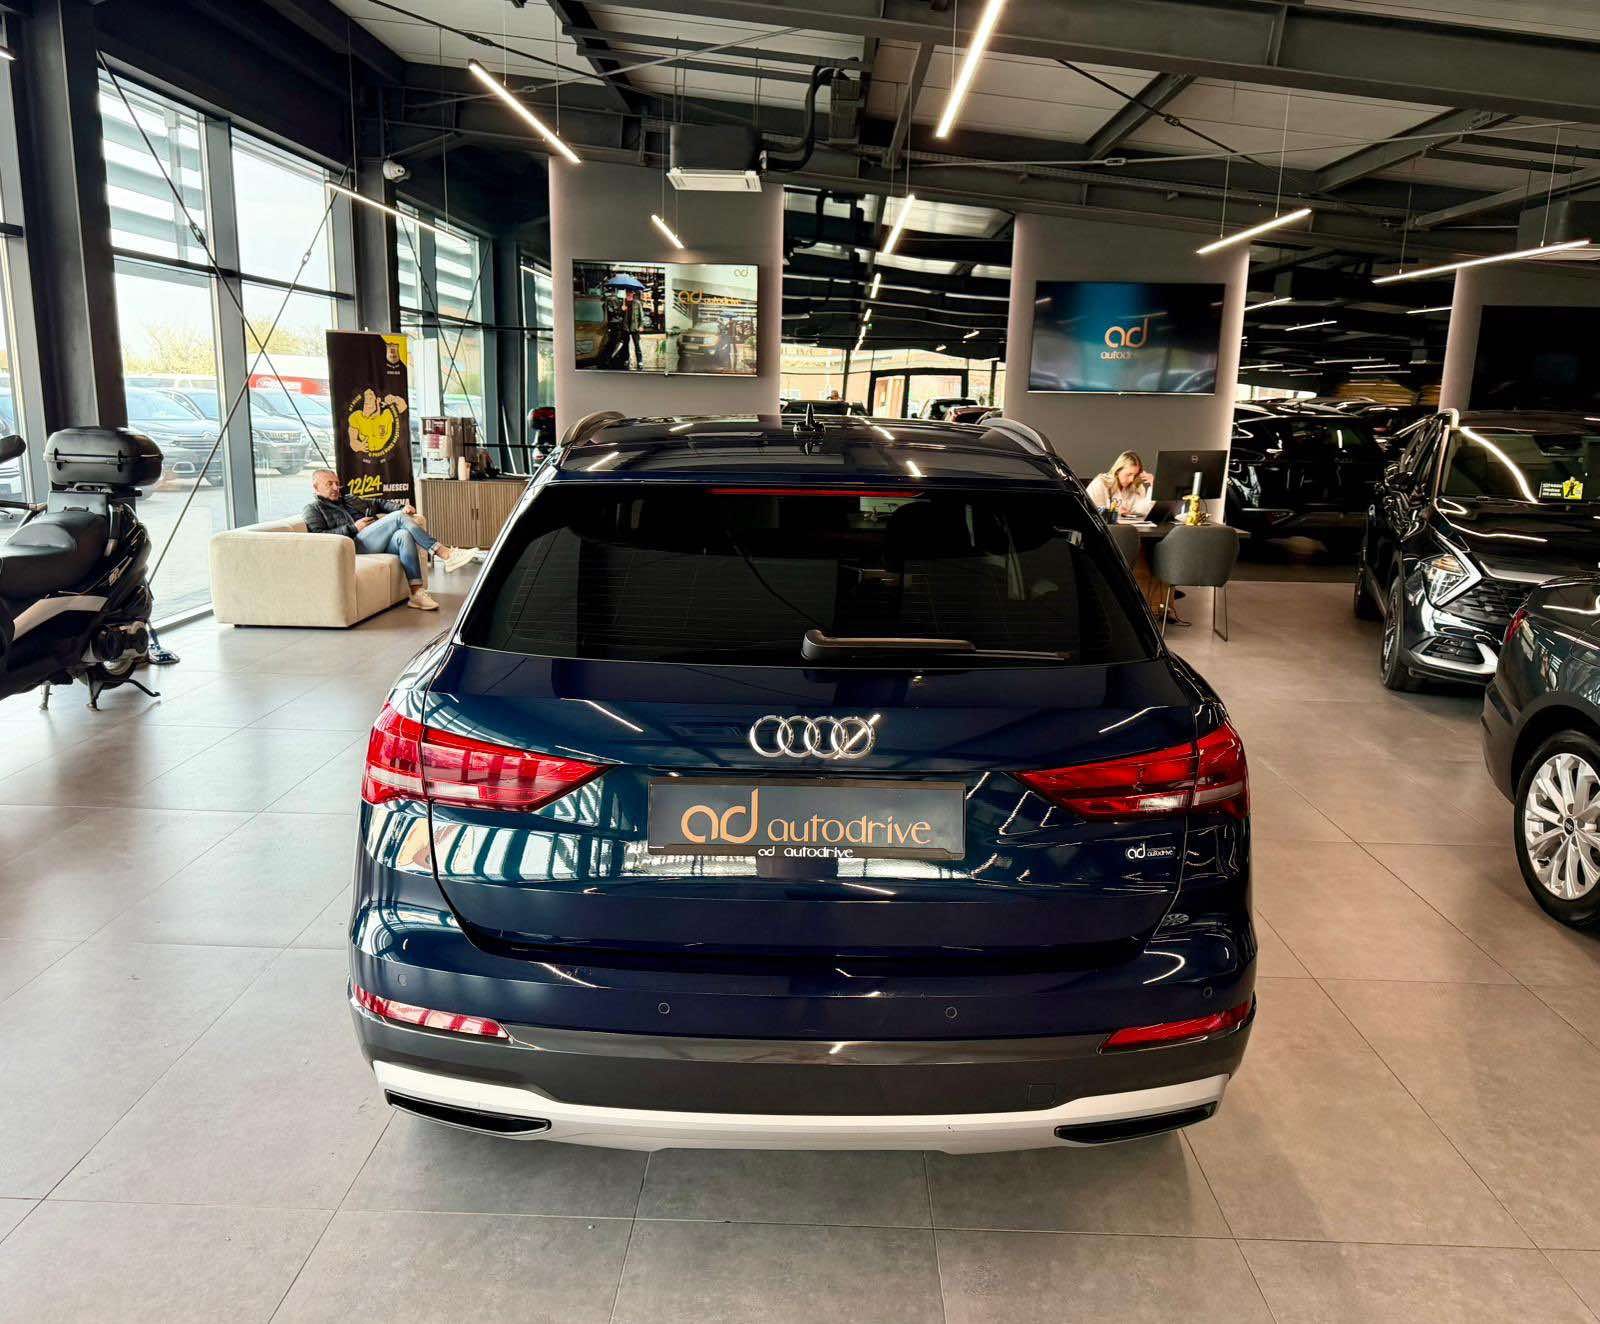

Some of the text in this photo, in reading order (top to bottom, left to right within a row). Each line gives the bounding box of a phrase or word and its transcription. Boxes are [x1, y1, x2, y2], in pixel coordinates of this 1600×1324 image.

[678, 288, 703, 305] ad
[1104, 317, 1148, 348] ad
[347, 474, 382, 496] 12/24
[680, 787, 932, 845] ad autodrive
[757, 846, 854, 859] ad autodrive
[1127, 843, 1146, 860] ad
